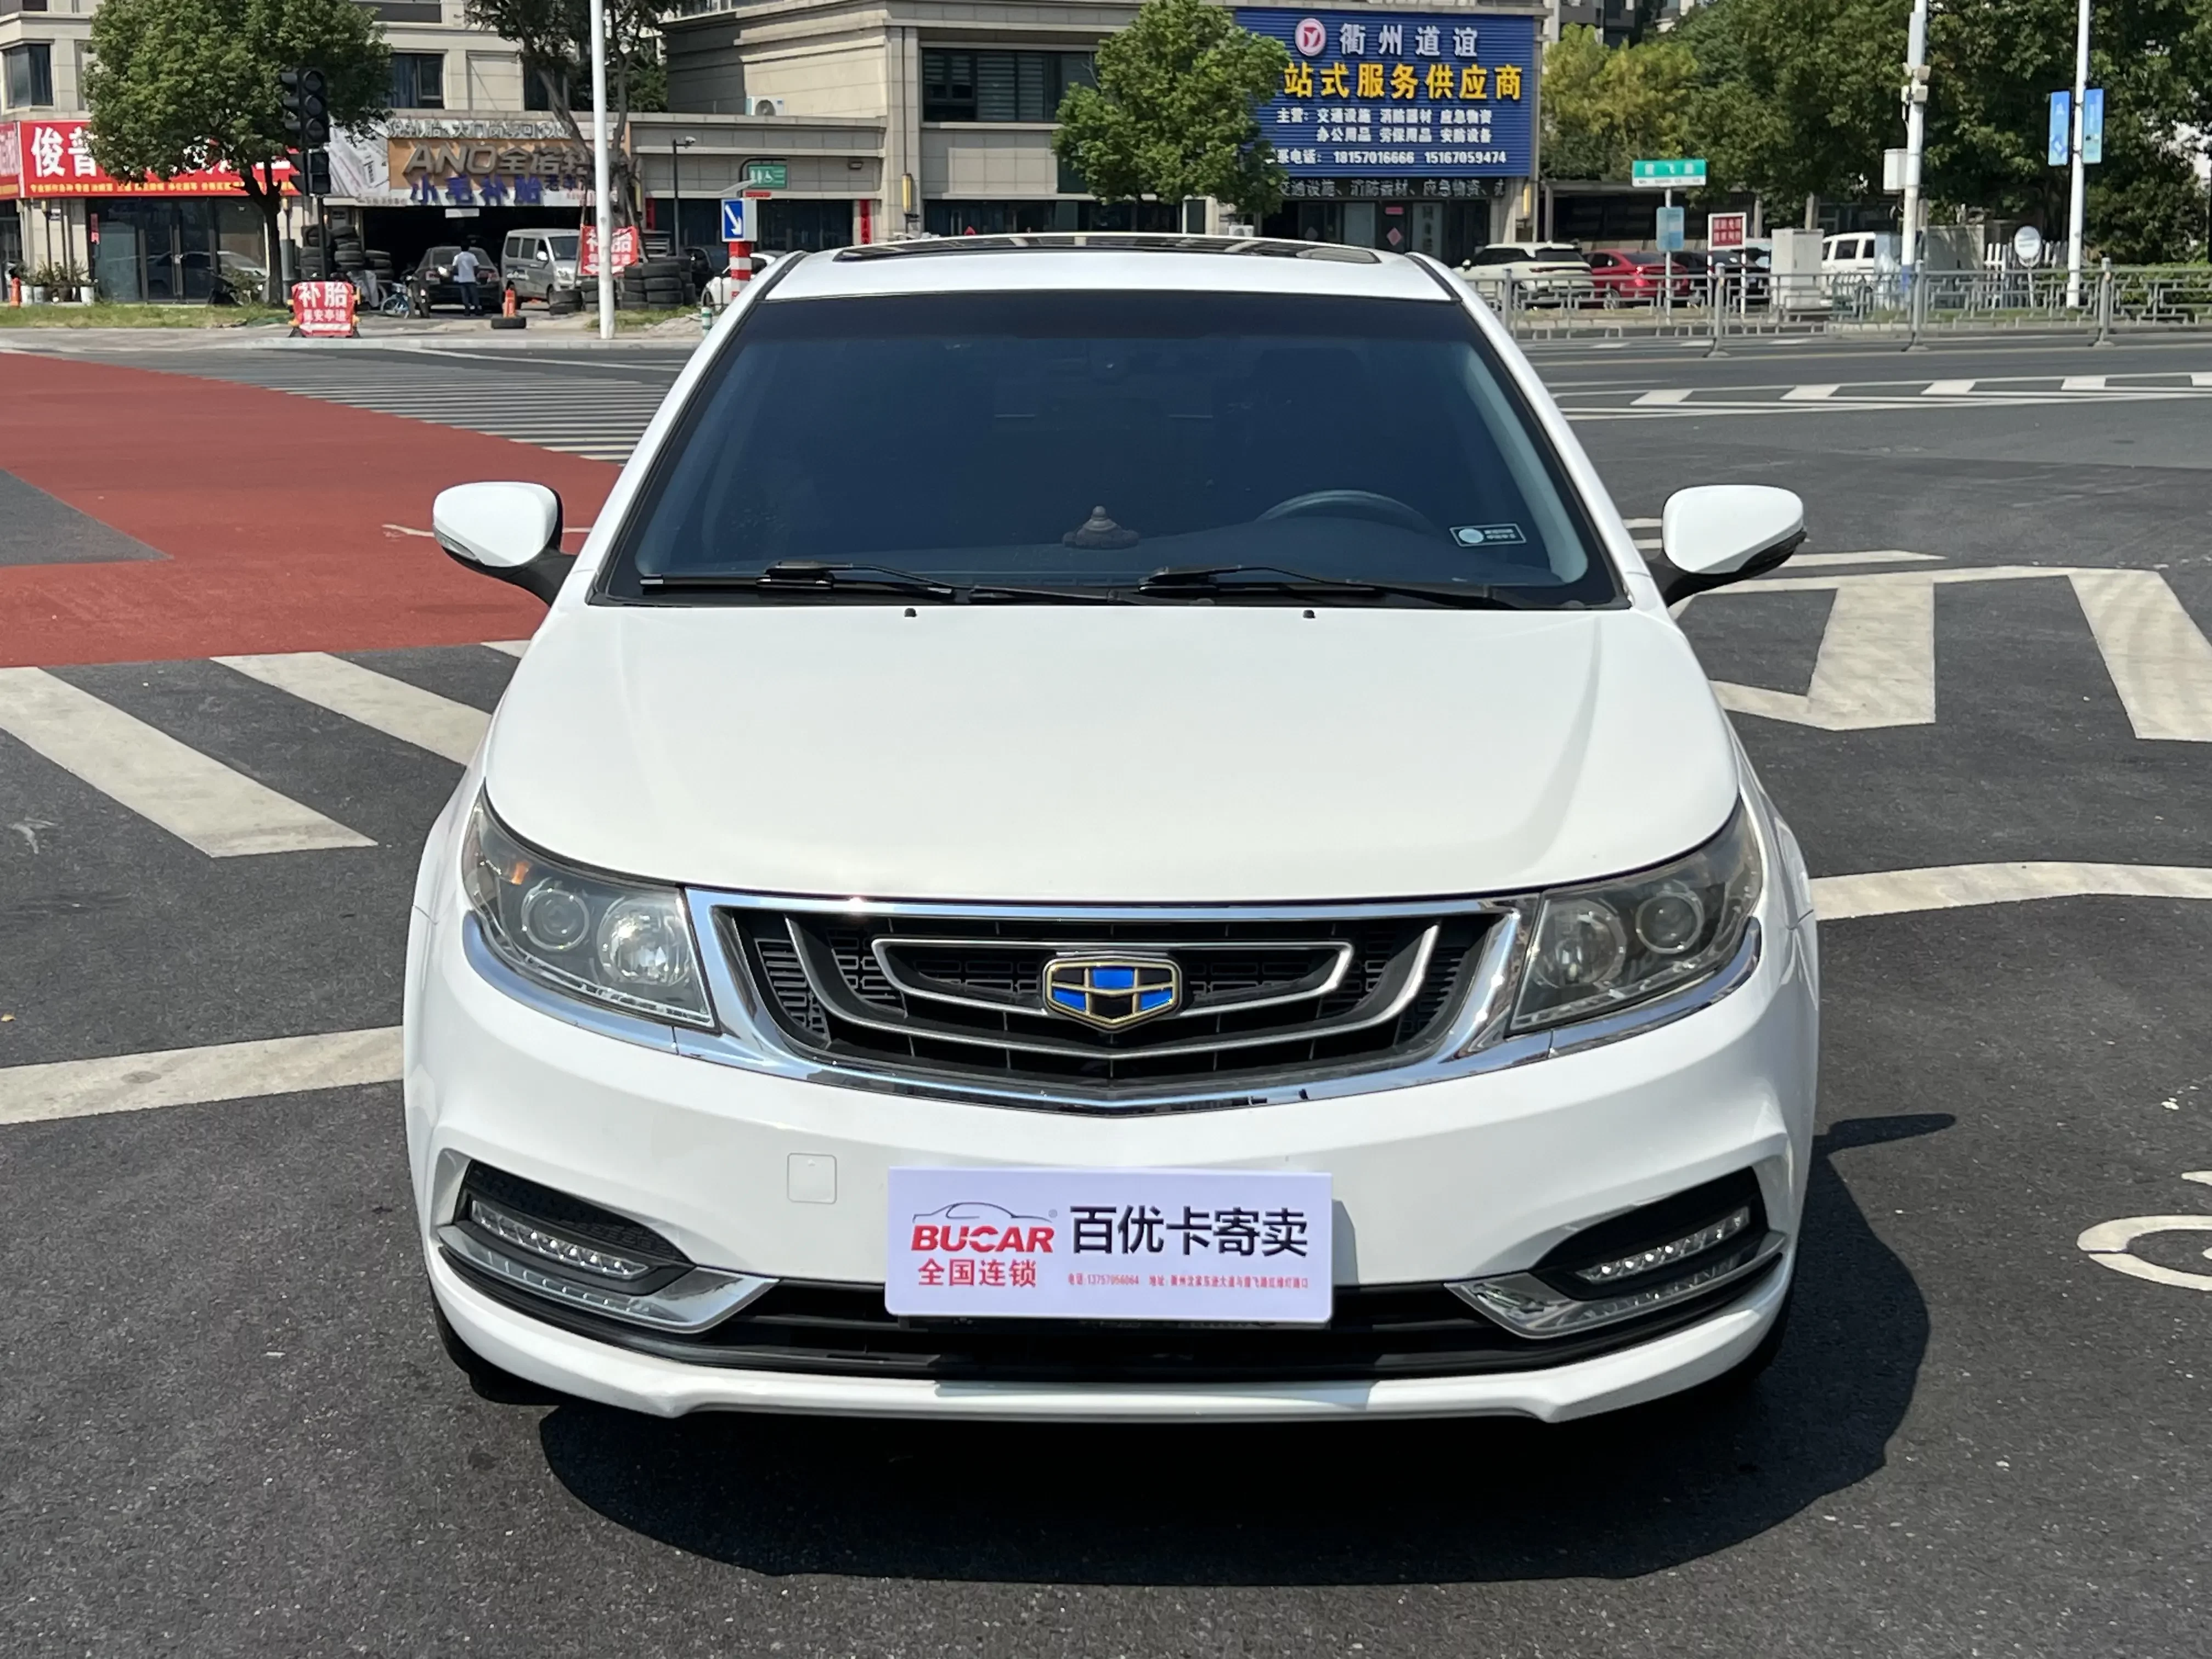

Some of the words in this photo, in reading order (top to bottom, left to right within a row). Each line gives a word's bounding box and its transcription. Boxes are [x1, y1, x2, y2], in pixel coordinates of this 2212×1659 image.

[1339, 22, 1478, 57] 衢州道谊
[1317, 108, 1372, 123] 交通设施
[1317, 126, 1372, 142] 办公用品
[404, 143, 495, 174] ANO
[298, 281, 348, 308] 补胎
[911, 1224, 1055, 1253] BUCAR
[1069, 1205, 1308, 1257] 百优卡寄卖
[917, 1257, 1037, 1288] 全国连锁
